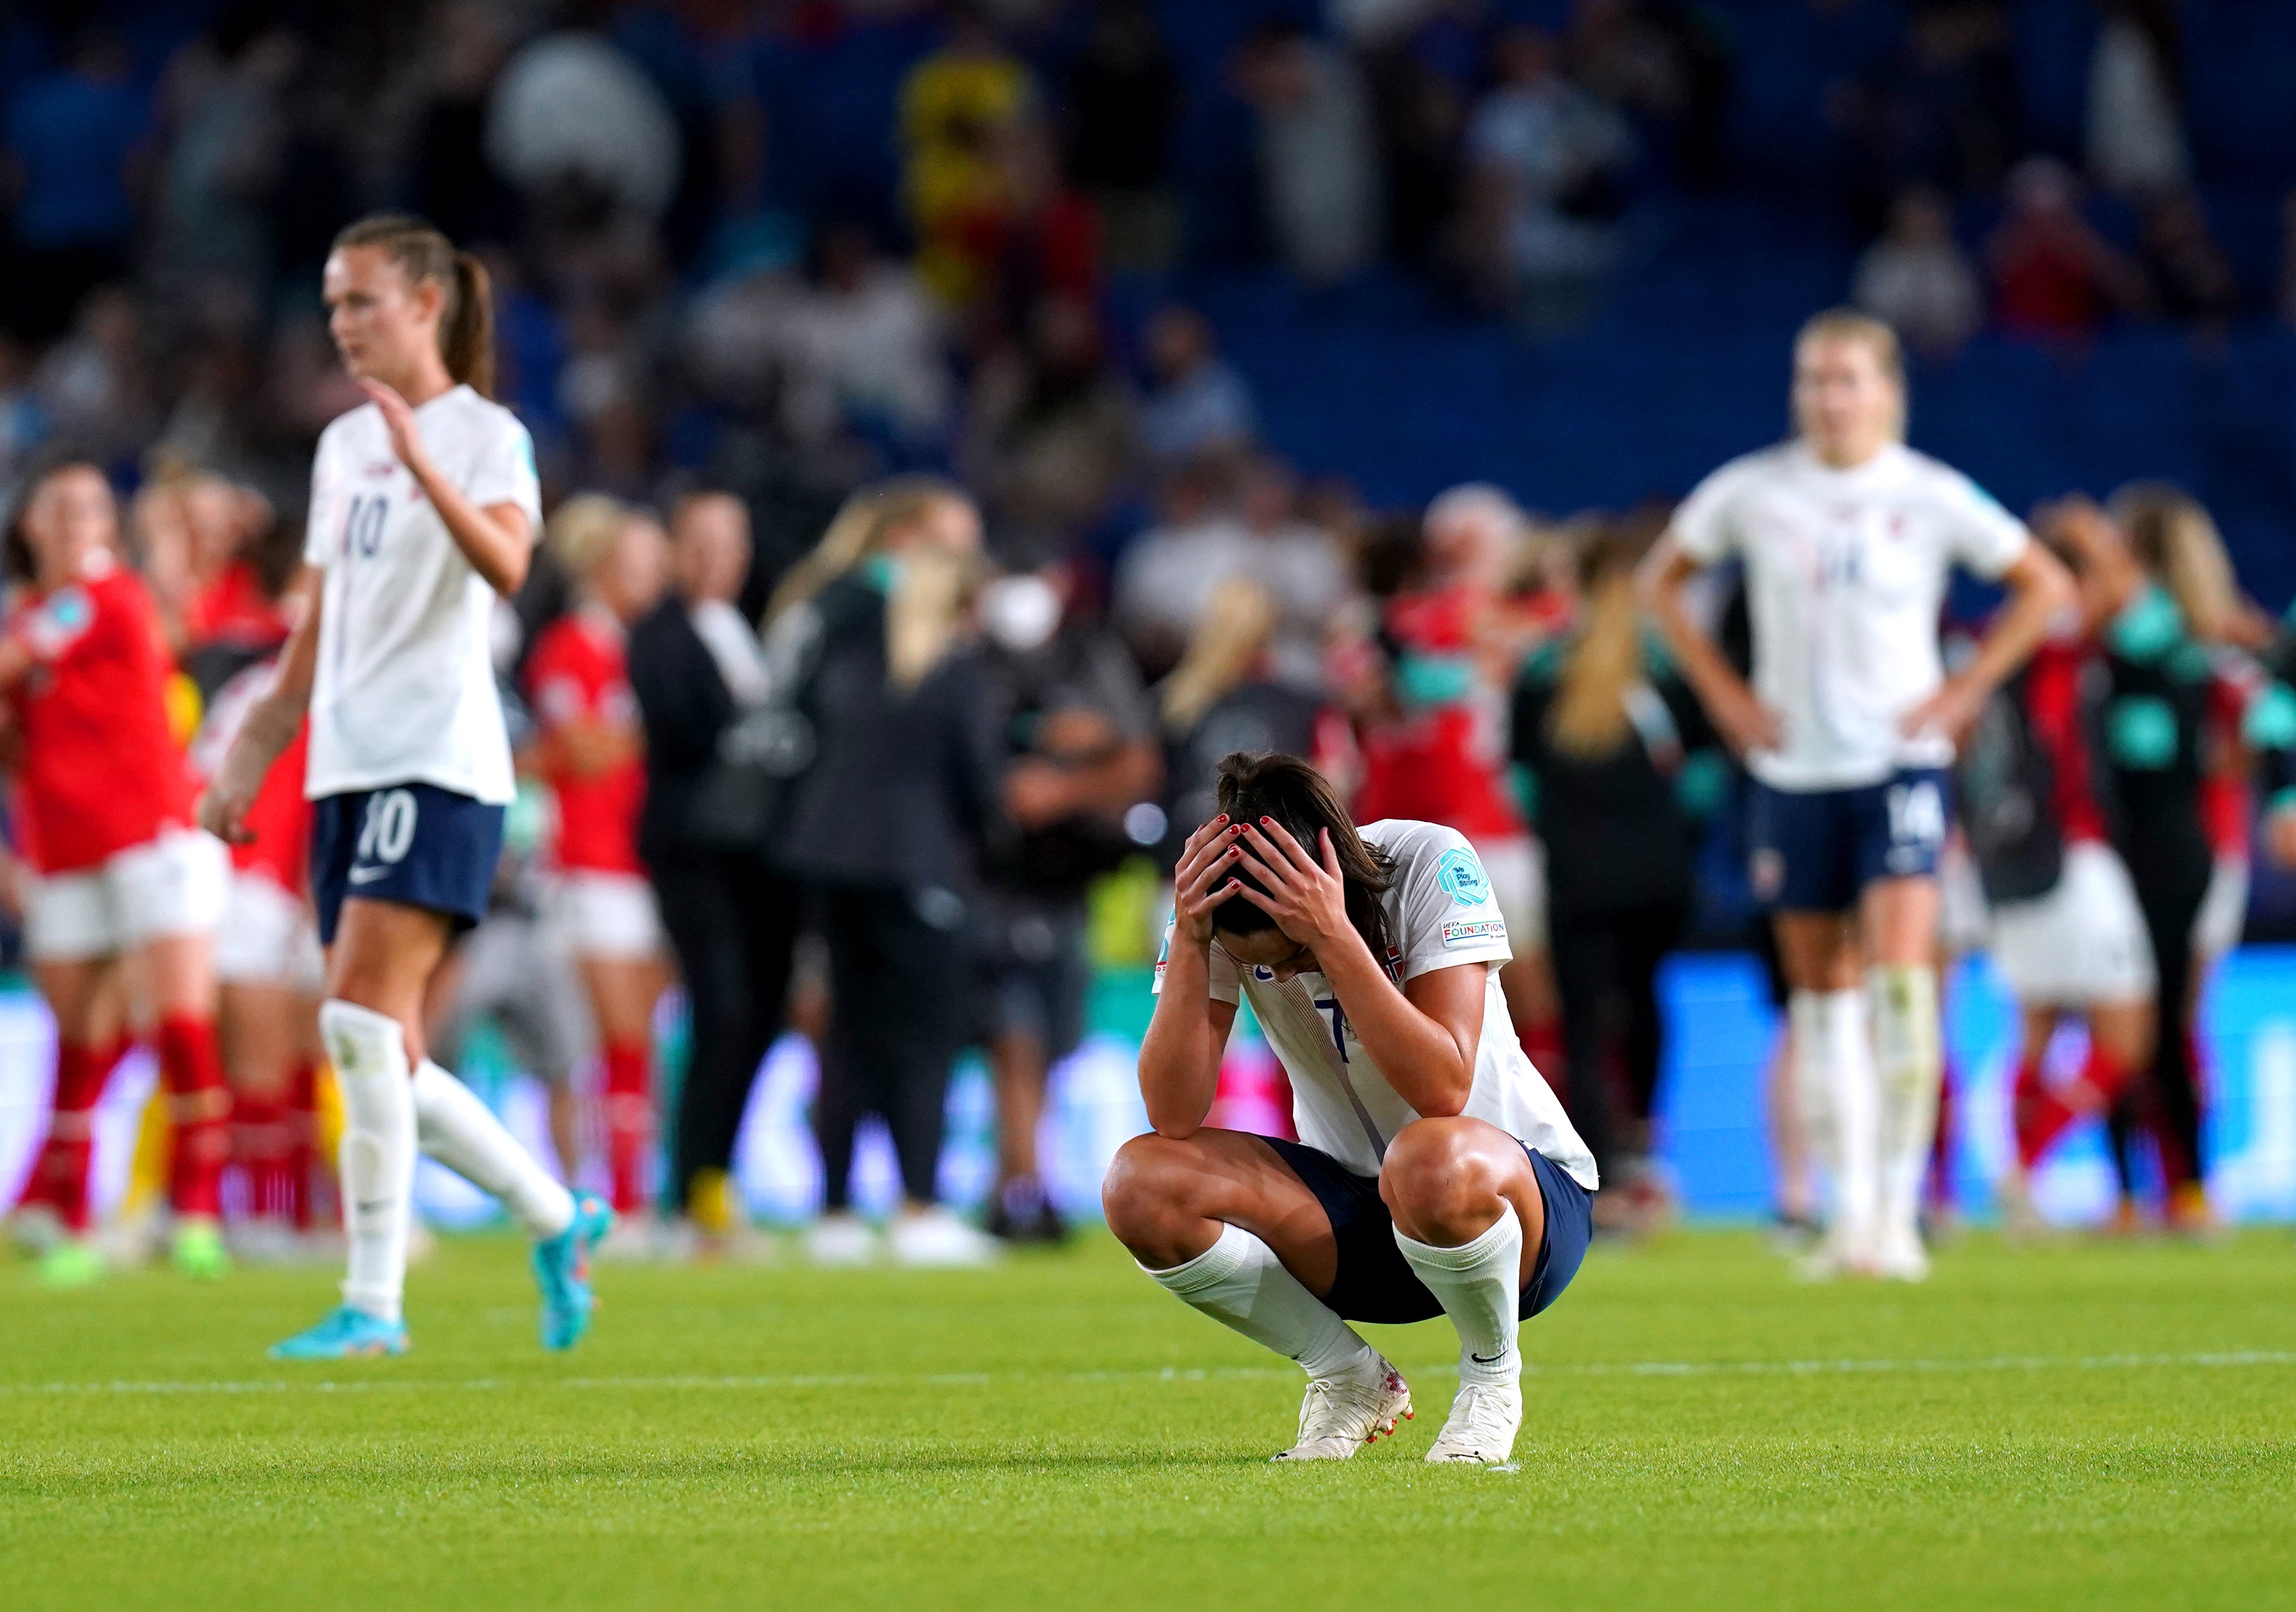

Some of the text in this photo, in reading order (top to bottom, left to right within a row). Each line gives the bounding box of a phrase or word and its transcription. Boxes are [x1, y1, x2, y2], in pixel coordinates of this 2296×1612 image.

[341, 495, 390, 559] 10
[357, 788, 418, 864] 10
[1444, 923, 1504, 938] FOUNDATION
[1314, 999, 1350, 1063] 7
